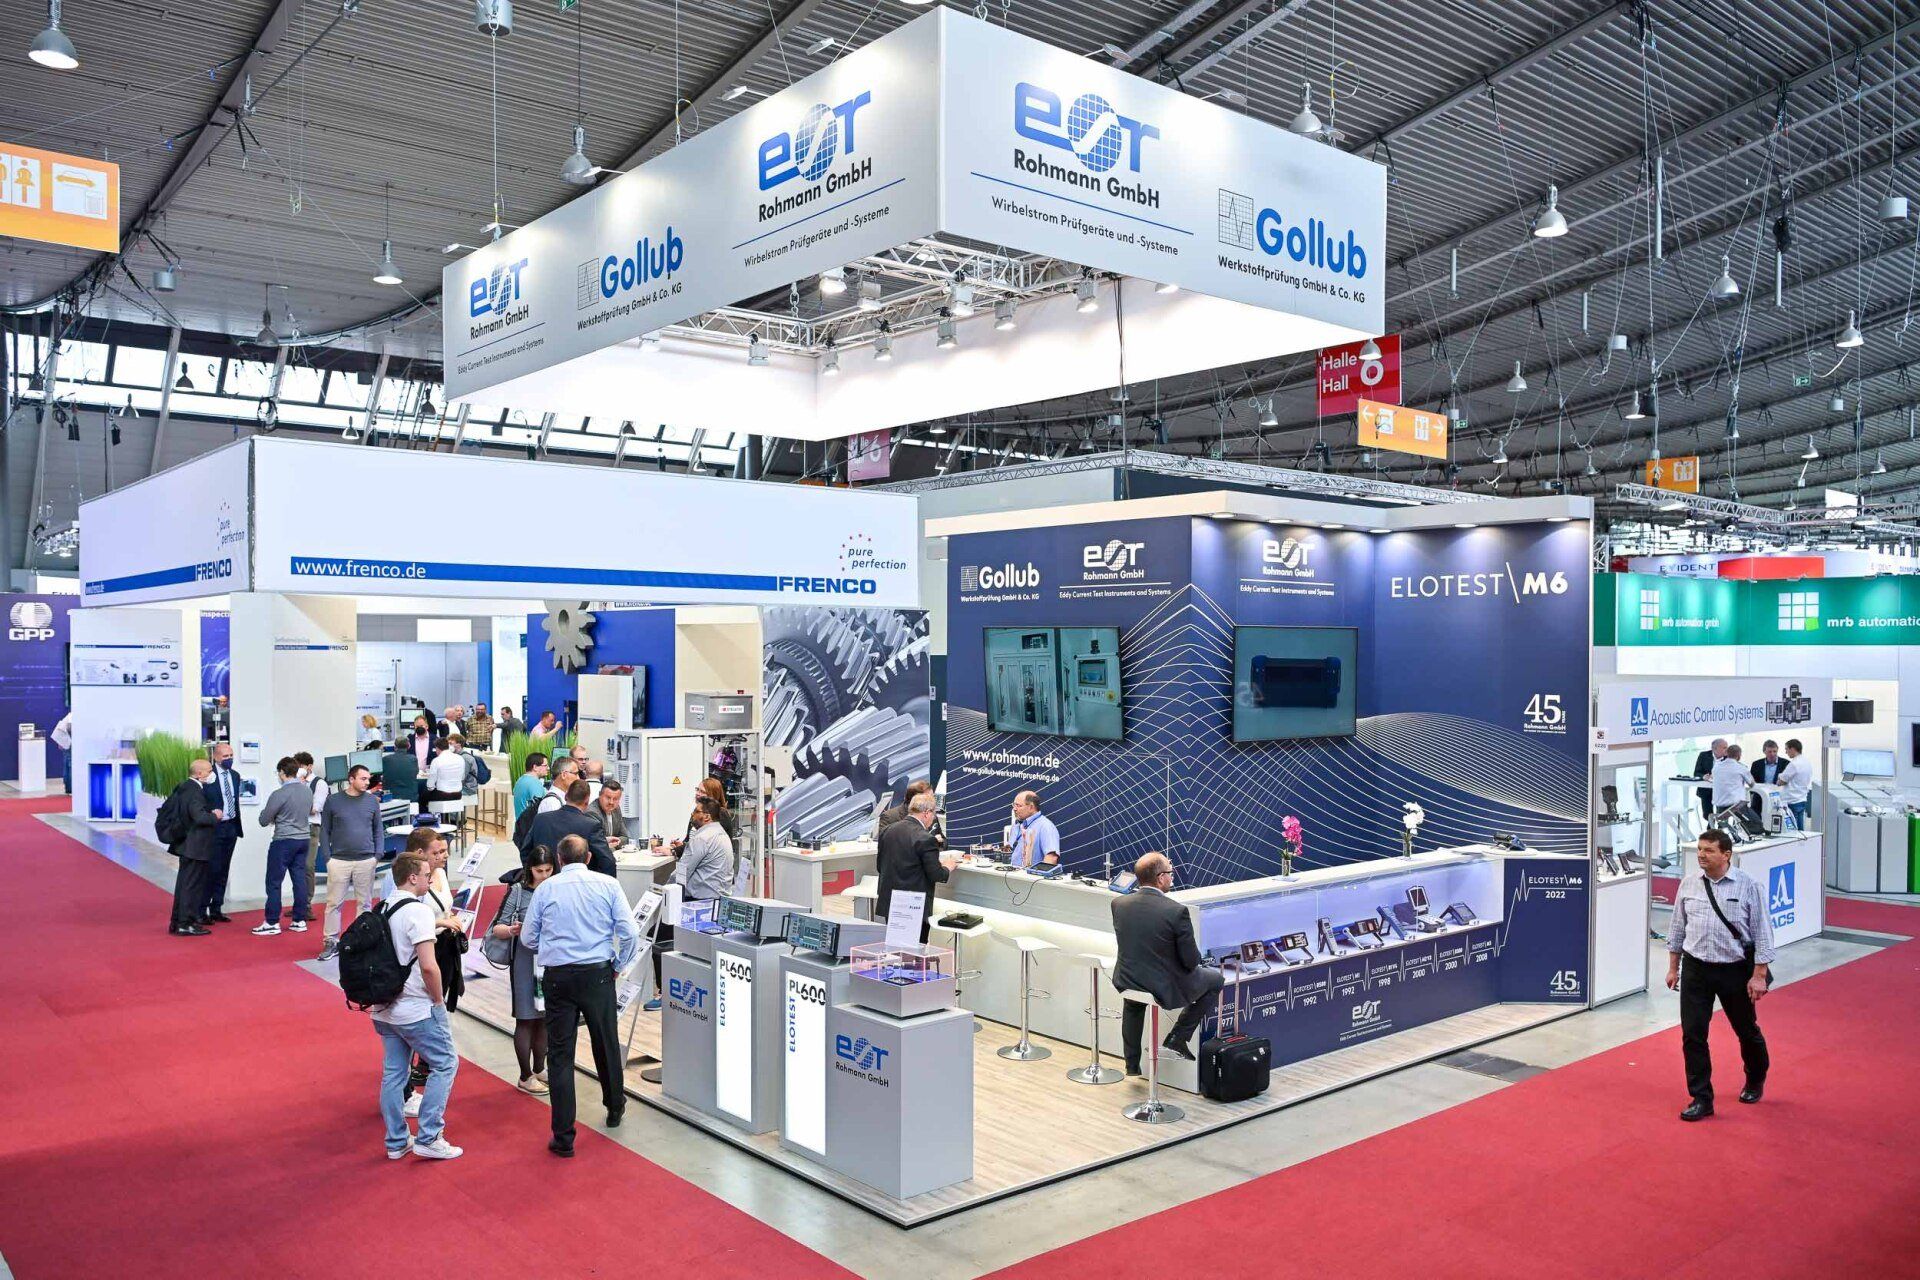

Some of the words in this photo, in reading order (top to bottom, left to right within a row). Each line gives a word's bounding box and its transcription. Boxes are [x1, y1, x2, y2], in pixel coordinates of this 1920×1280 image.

[1014, 148, 1101, 192] Rohmann
[1107, 177, 1160, 209] GmbH
[759, 185, 821, 222] Rohmann
[826, 157, 871, 194] GmbH
[991, 196, 1058, 225] Wirbelstrom
[1060, 215, 1115, 239] Prüfgeräte
[1117, 229, 1134, 244] und
[1136, 235, 1179, 256] -Systeme
[744, 244, 788, 267] Wirbelstrom
[790, 228, 832, 251] Prüfgeräte
[833, 221, 849, 239] und
[851, 206, 889, 228] -Systeme
[1256, 207, 1367, 279] Gollub
[601, 226, 683, 299] Gollub
[1218, 255, 1300, 289] Werkstoffprüfung
[1302, 278, 1328, 293] GmbH
[1330, 285, 1336, 296] &
[1338, 288, 1351, 300] Co.
[1353, 291, 1365, 303] KG
[577, 304, 630, 331] Werkstoffprüfung
[632, 295, 652, 311] GmbH
[652, 292, 658, 302] &
[659, 288, 670, 300] Co.
[671, 282, 682, 296] KG
[471, 318, 504, 340] Rohmann
[506, 305, 529, 326] GmbH
[1322, 351, 1358, 371] Halle
[1322, 374, 1349, 394] Hall
[219, 519, 231, 532] pure
[221, 530, 245, 546] perfection
[848, 547, 873, 558] pure
[196, 558, 232, 581] FRENCO
[295, 560, 426, 578] www.frenco.de
[851, 559, 907, 570] perfection
[1262, 566, 1293, 577] Rohmann
[1294, 568, 1315, 578] GmbH
[979, 562, 1040, 589] Gollub
[1083, 571, 1118, 581] Rohmann
[1120, 569, 1145, 579] GmbH
[779, 576, 877, 595] FRENCO
[1059, 591, 1072, 599] Eddy
[1104, 589, 1136, 597] Instruments
[1148, 588, 1171, 596] Systems
[1827, 616, 1854, 627] mrb
[8, 628, 55, 641] GPP
[1523, 693, 1562, 724] 45
[1650, 709, 1692, 726] Acoustic
[1694, 706, 1726, 723] Control
[1728, 704, 1764, 724] Systems
[1631, 727, 1649, 736] ACS
[963, 748, 1060, 768] www.rohmann.de
[1545, 890, 1566, 899] 2022
[1444, 960, 1458, 970] 2000
[1475, 952, 1488, 963] 2008
[720, 958, 752, 983] PL600
[1412, 968, 1426, 979] 2000
[1378, 977, 1391, 987] 1998
[1550, 970, 1577, 991] 45
[789, 979, 826, 1006] PL600
[1342, 986, 1355, 996] 1992
[1303, 995, 1317, 1007] 1992
[669, 1001, 691, 1016] Rohmann
[692, 1010, 709, 1023] GmbH
[1262, 1006, 1277, 1018] 1978
[1221, 1017, 1234, 1027] 977
[835, 1061, 866, 1080] Rohmann
[867, 1073, 889, 1088] GmbH
